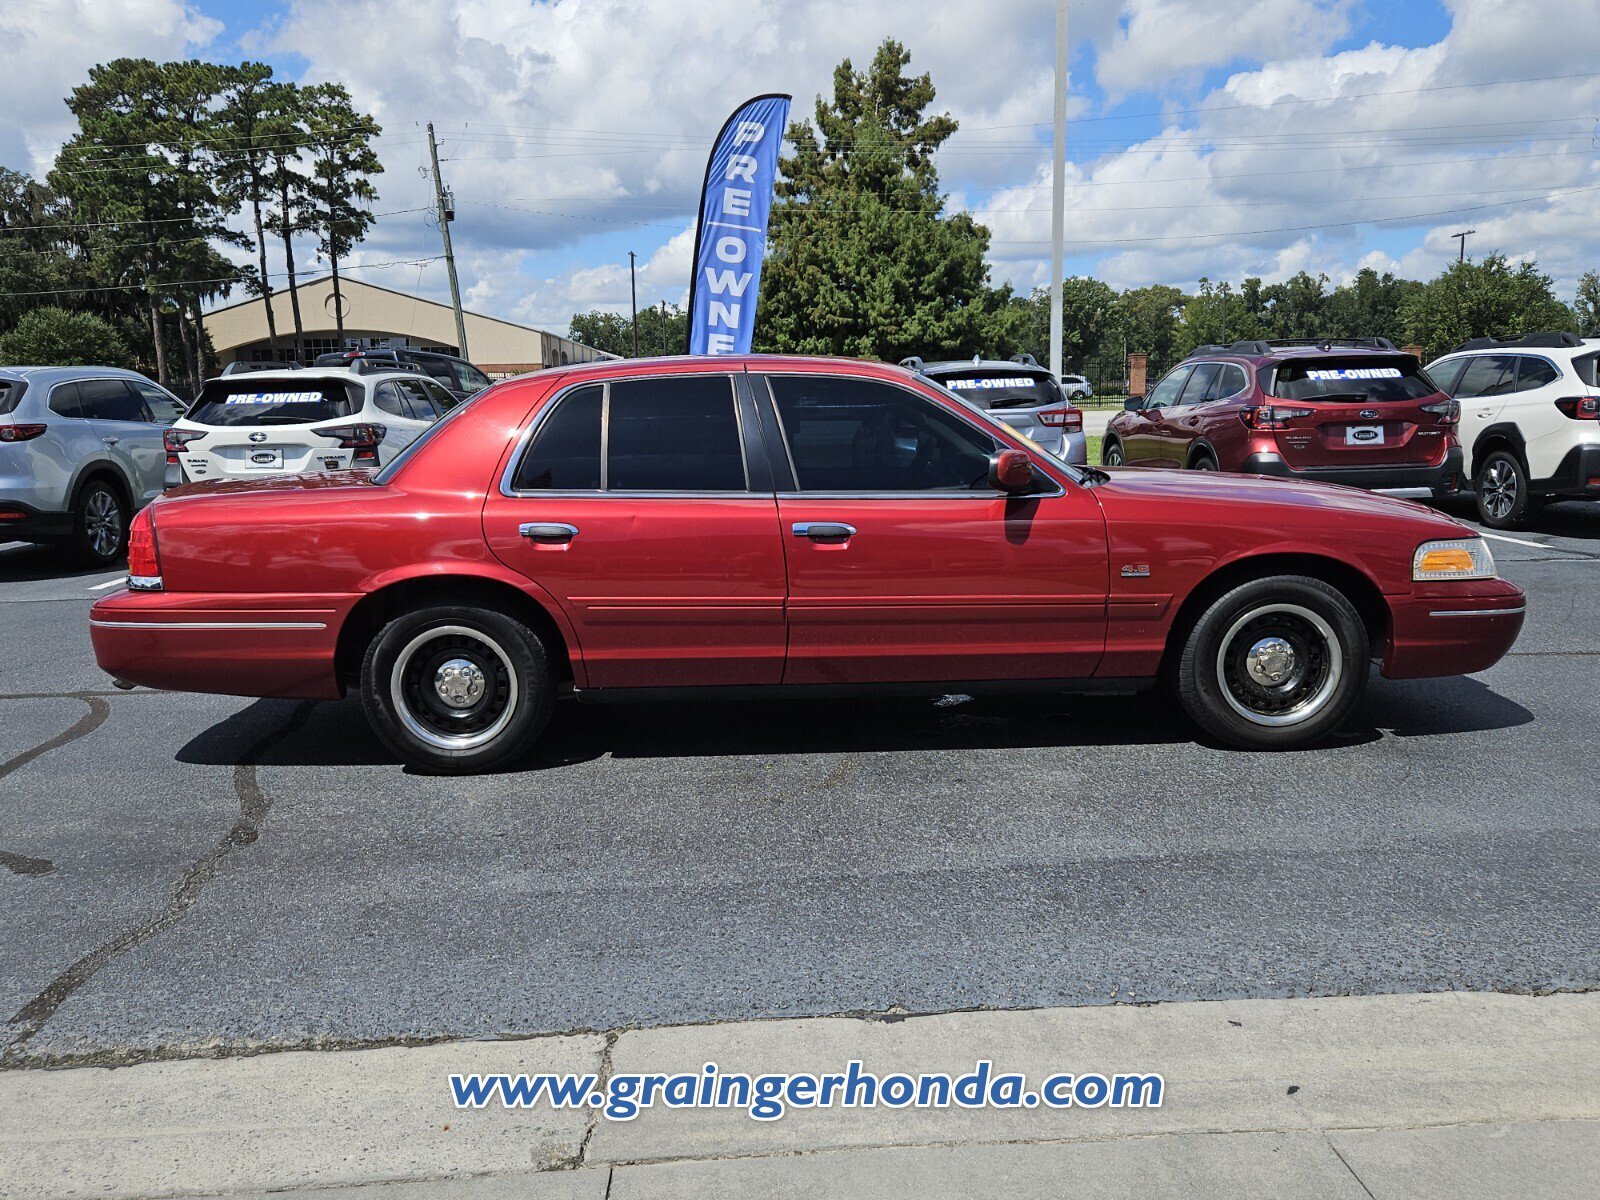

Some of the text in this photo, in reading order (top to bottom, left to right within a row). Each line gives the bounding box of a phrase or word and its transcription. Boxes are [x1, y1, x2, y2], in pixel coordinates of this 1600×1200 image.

[1305, 367, 1402, 381] PRE-OWNED
[945, 377, 1035, 390] PRE-OWNED
[225, 392, 323, 405] PRE-OWNED
